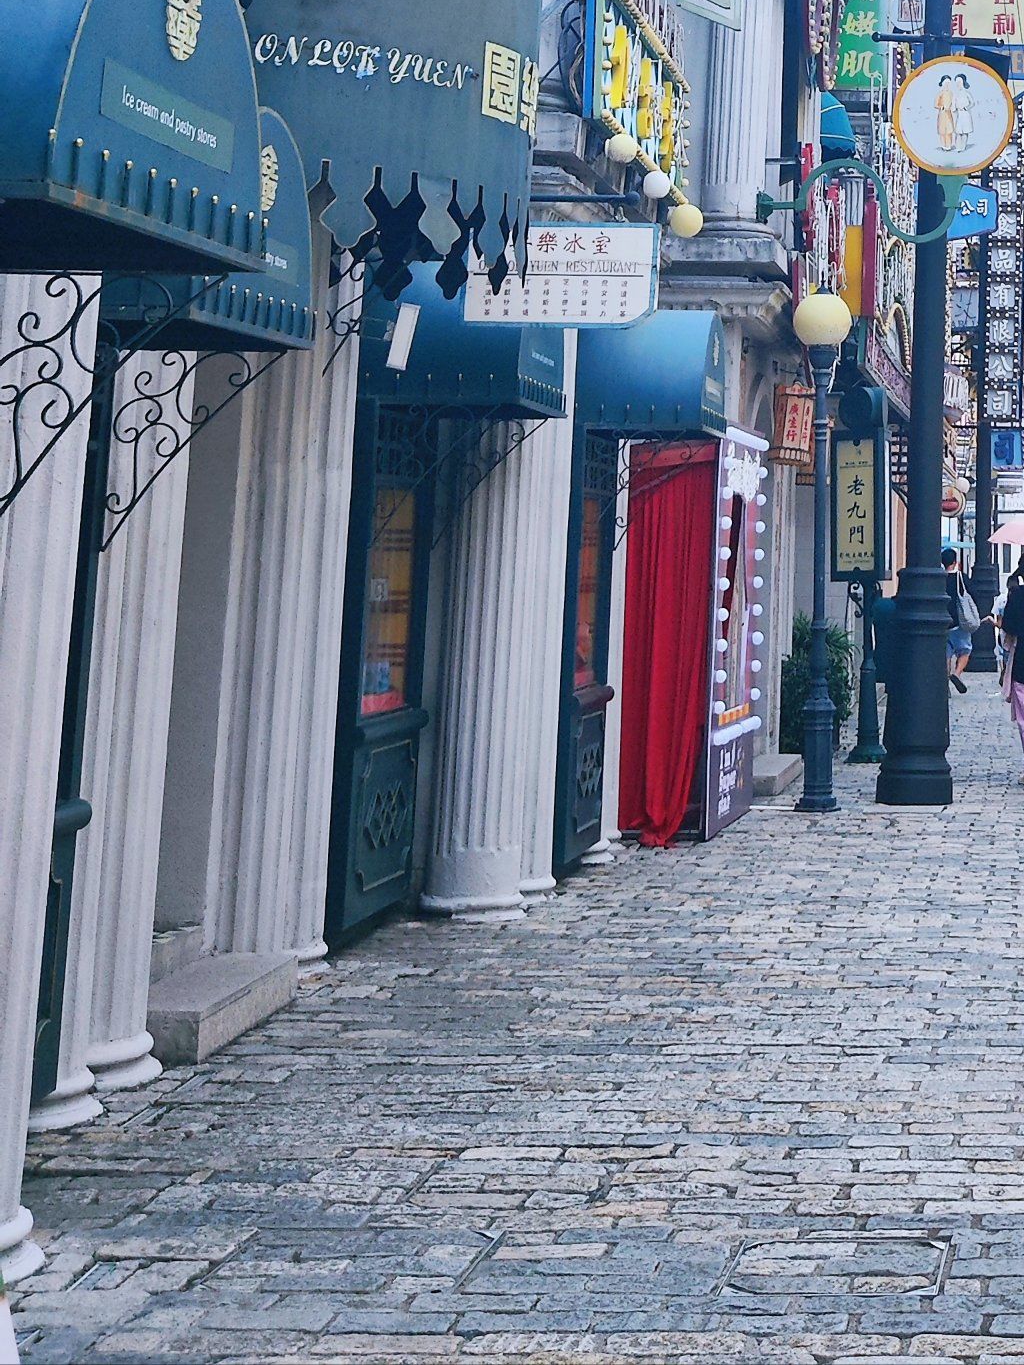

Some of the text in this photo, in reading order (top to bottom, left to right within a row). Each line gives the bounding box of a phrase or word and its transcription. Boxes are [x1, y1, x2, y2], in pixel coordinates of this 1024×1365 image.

[254, 34, 307, 66] ON
[386, 47, 469, 89] YUEN
[122, 84, 218, 149] Ice cream and pastry stores
[960, 199, 989, 218] 公司
[530, 260, 560, 272] YUEN
[566, 259, 640, 273] RESTAURANT
[846, 474, 866, 545] 老九門
